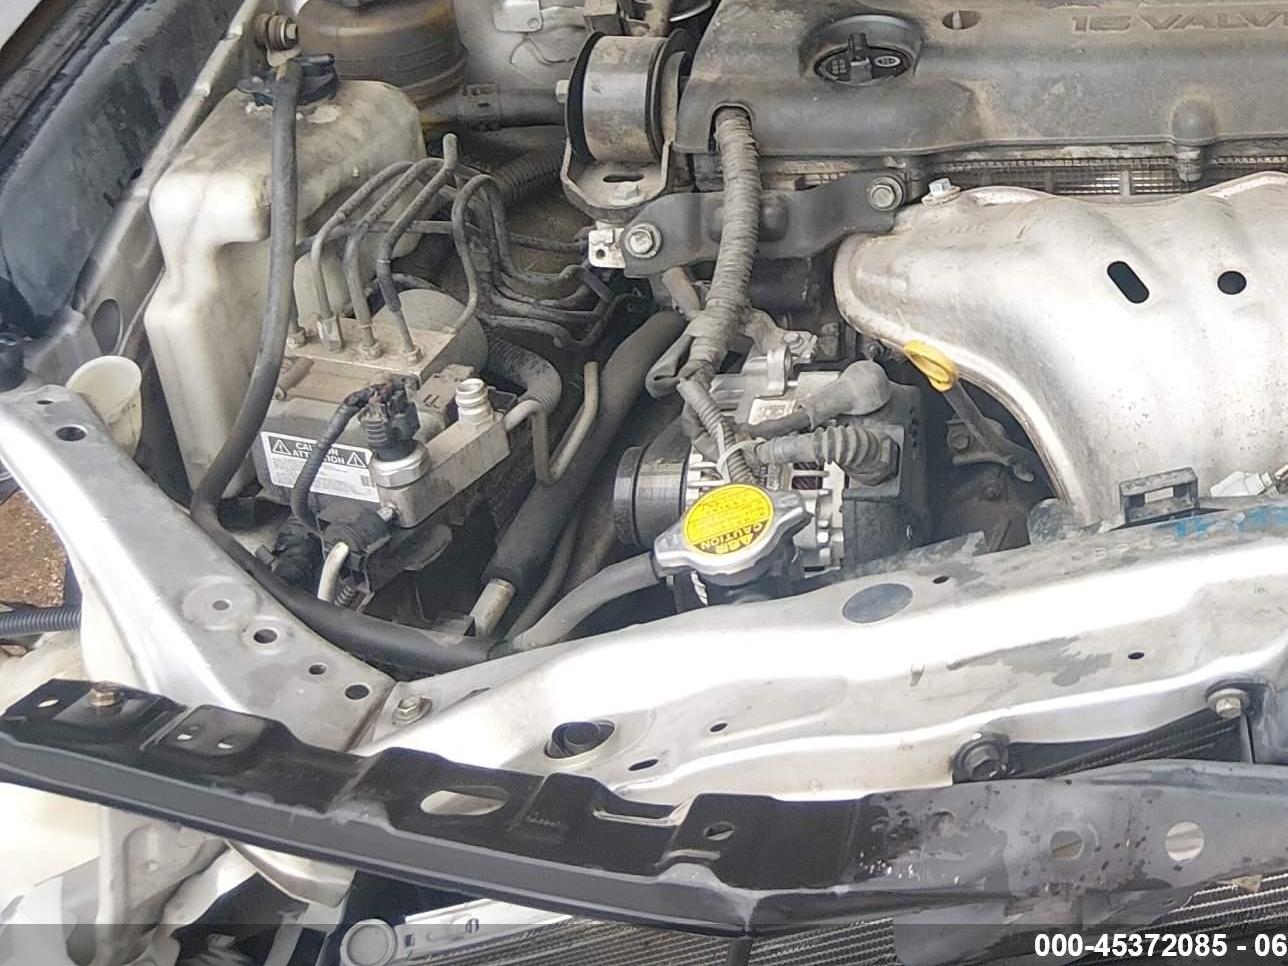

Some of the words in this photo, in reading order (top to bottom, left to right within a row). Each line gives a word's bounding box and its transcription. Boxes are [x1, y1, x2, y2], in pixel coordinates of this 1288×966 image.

[1072, 15, 1132, 33] 16
[292, 449, 345, 464] ATTION
[700, 522, 763, 550] CAUTION
